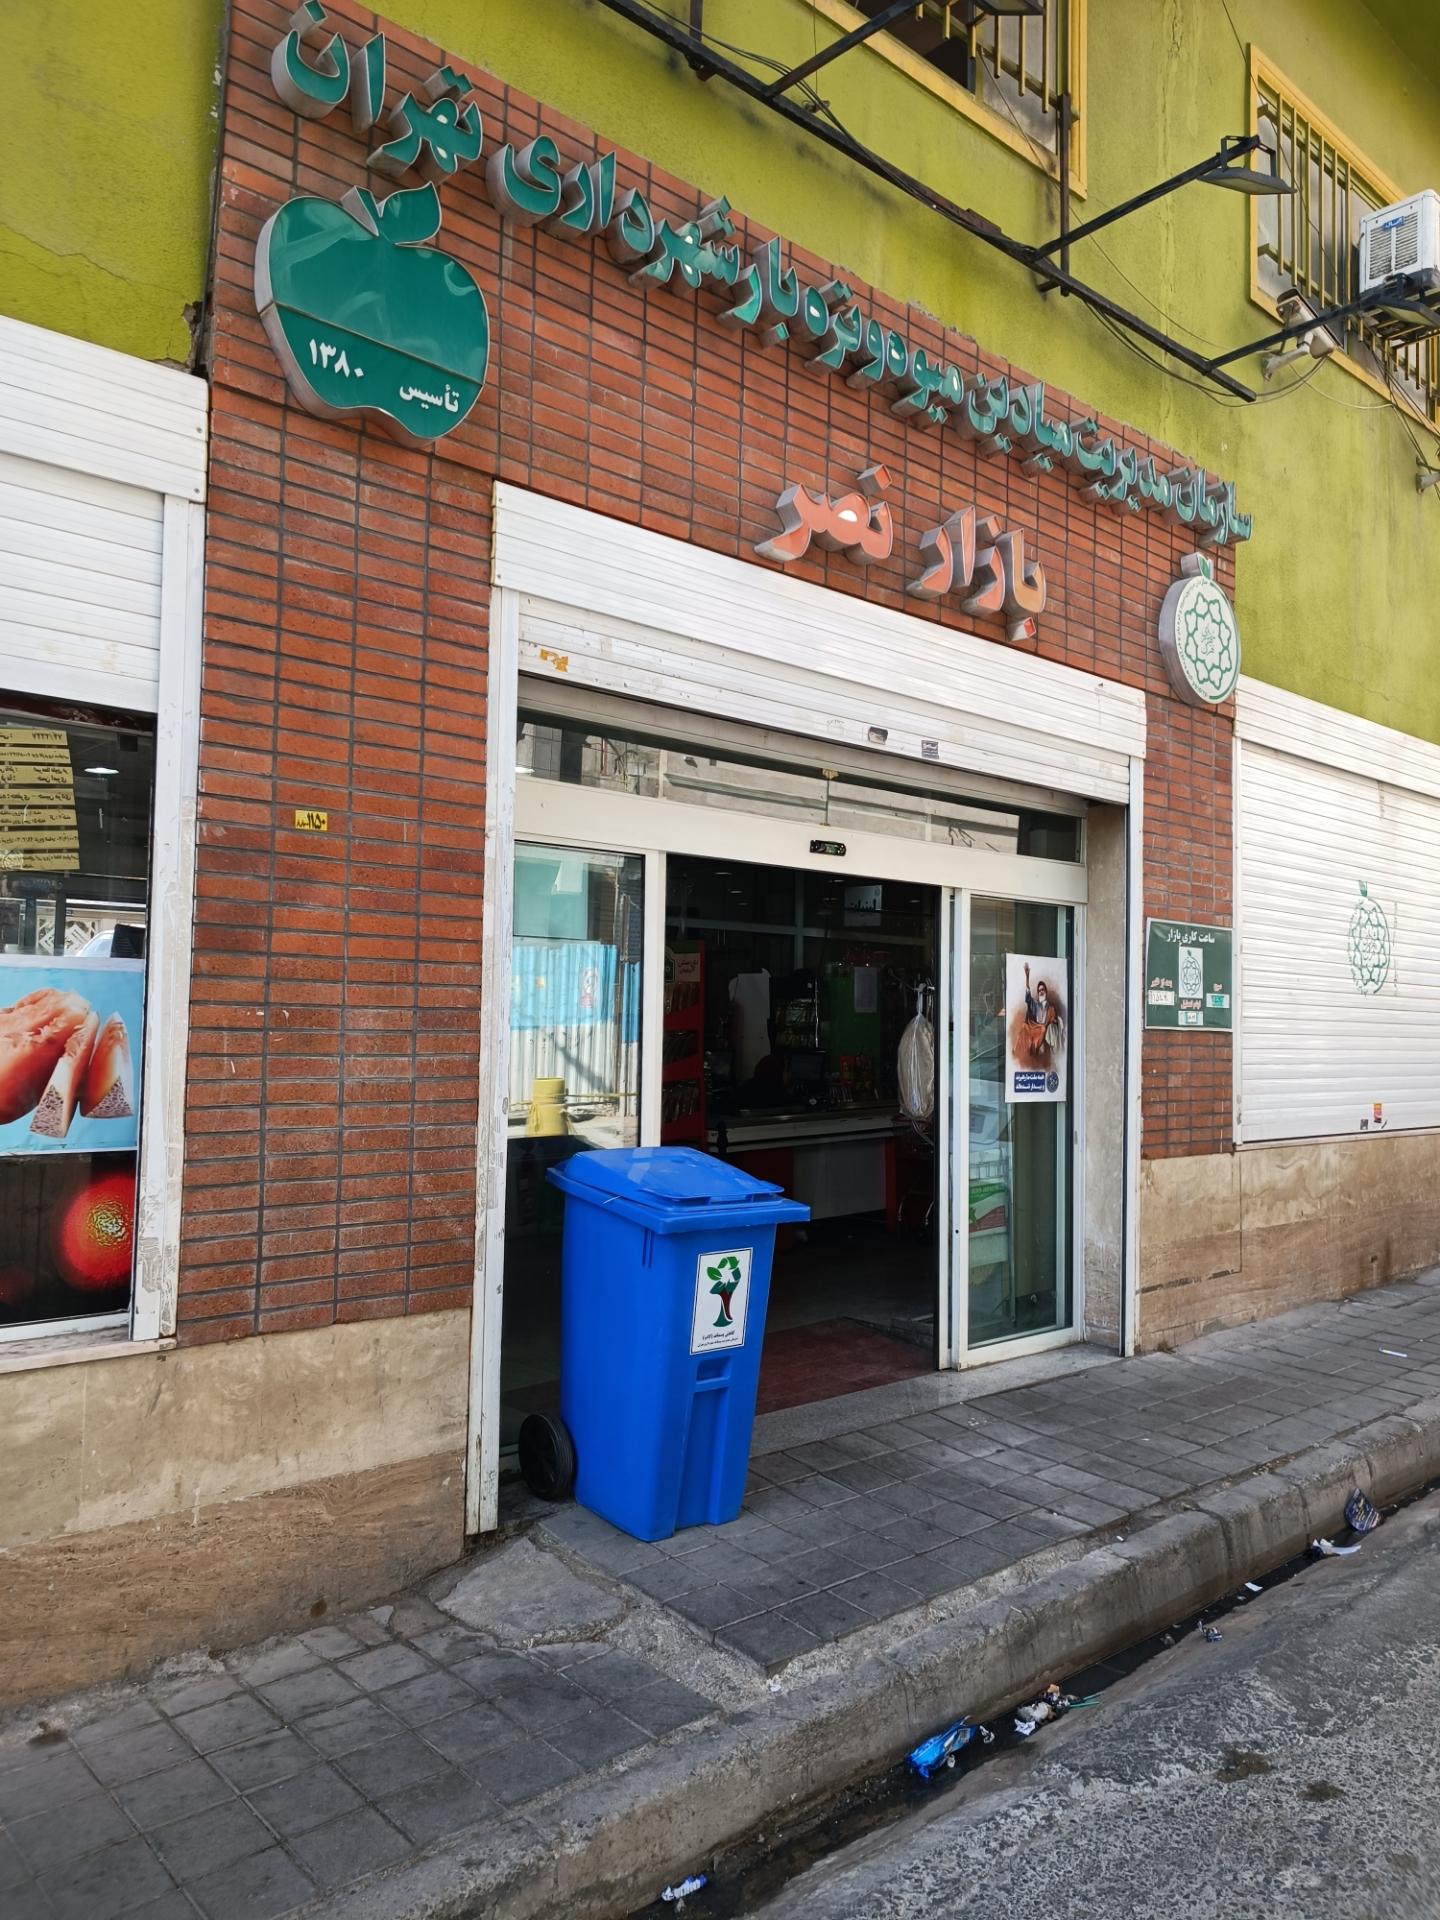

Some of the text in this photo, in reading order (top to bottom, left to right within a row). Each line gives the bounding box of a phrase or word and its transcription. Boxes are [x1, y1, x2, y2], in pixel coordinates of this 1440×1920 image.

[278, 0, 484, 174] تهران
[498, 133, 738, 290] شهرداری
[733, 235, 800, 340] بار
[308, 337, 461, 414] تأسیس ۱۳۸۰
[860, 318, 886, 383] و
[887, 329, 966, 426] میوه
[967, 374, 1074, 477] میادین
[1075, 415, 1173, 513] مدیریت
[756, 461, 893, 563] نصر
[1174, 466, 1252, 546] سازمان
[908, 504, 1048, 640] بازار
[1166, 927, 1215, 945] ساعت کاری بازار
